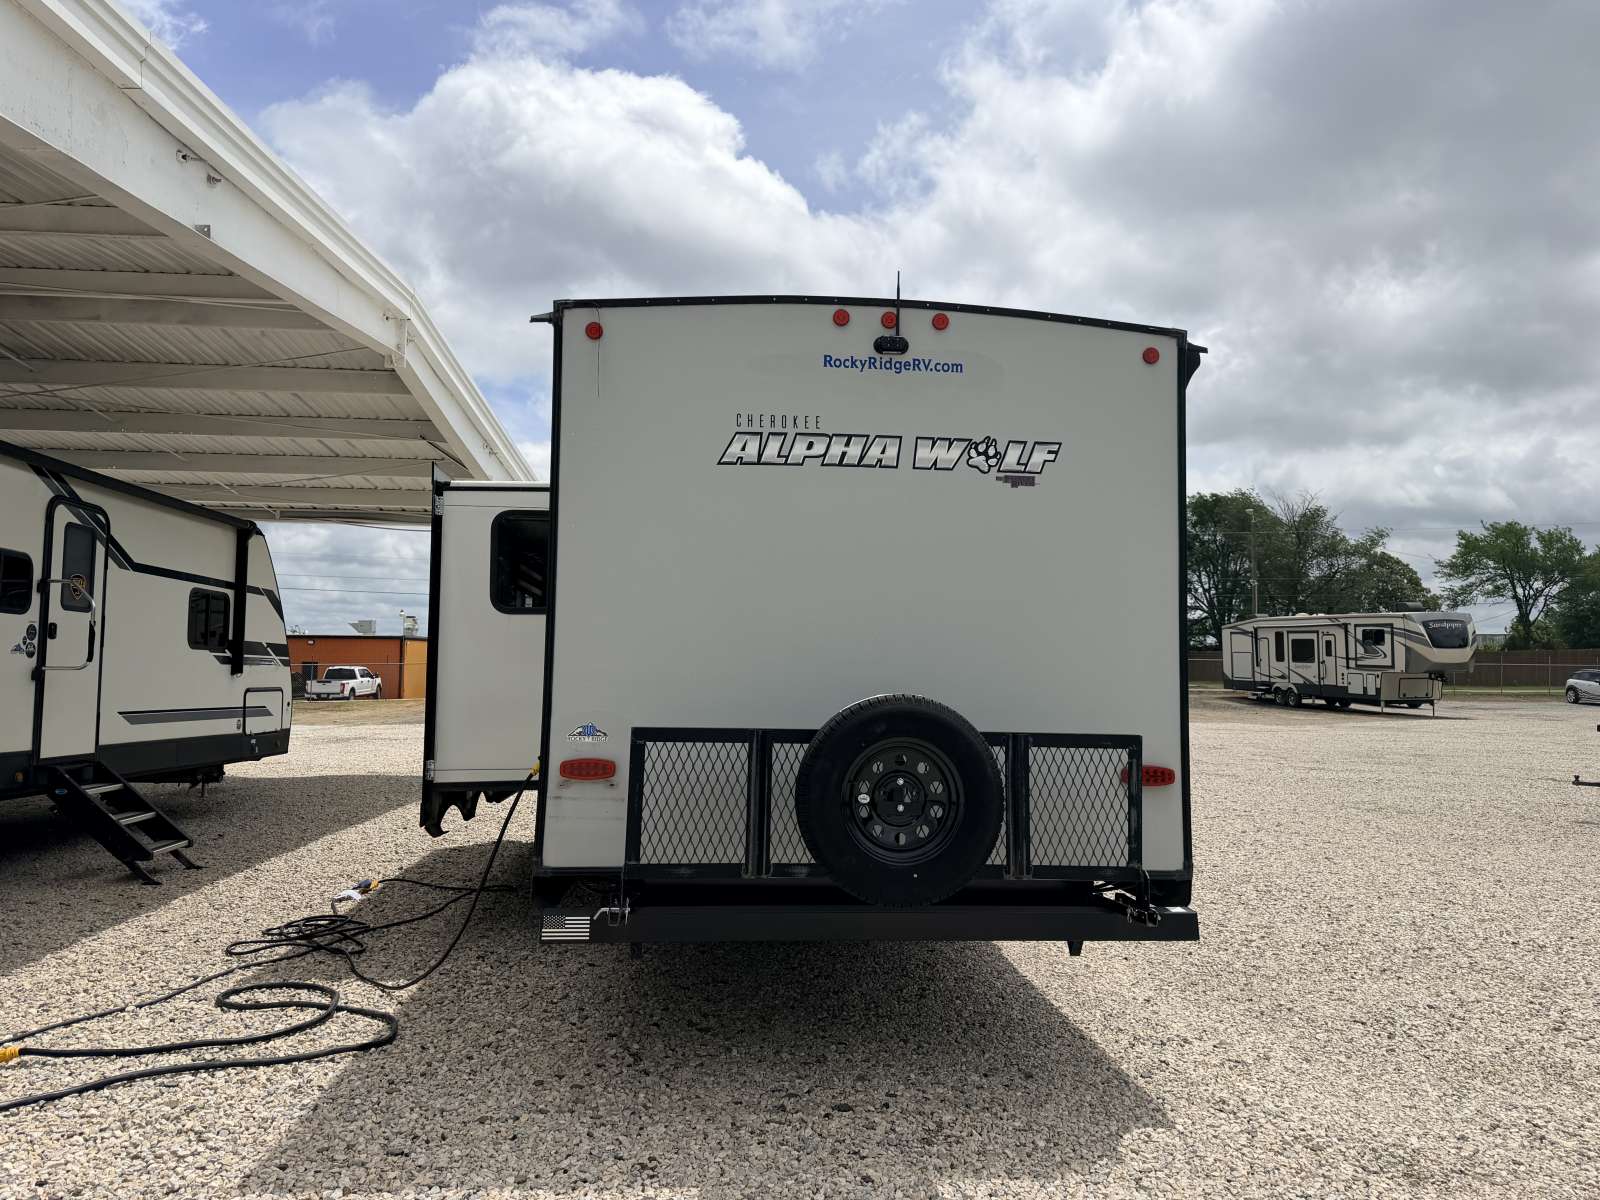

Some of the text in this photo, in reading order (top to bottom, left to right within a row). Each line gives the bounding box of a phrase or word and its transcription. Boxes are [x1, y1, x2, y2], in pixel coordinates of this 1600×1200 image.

[823, 354, 963, 374] RockyRidgeRV.com
[736, 413, 821, 429] CHEROKEE
[717, 431, 902, 469] ALPHA
